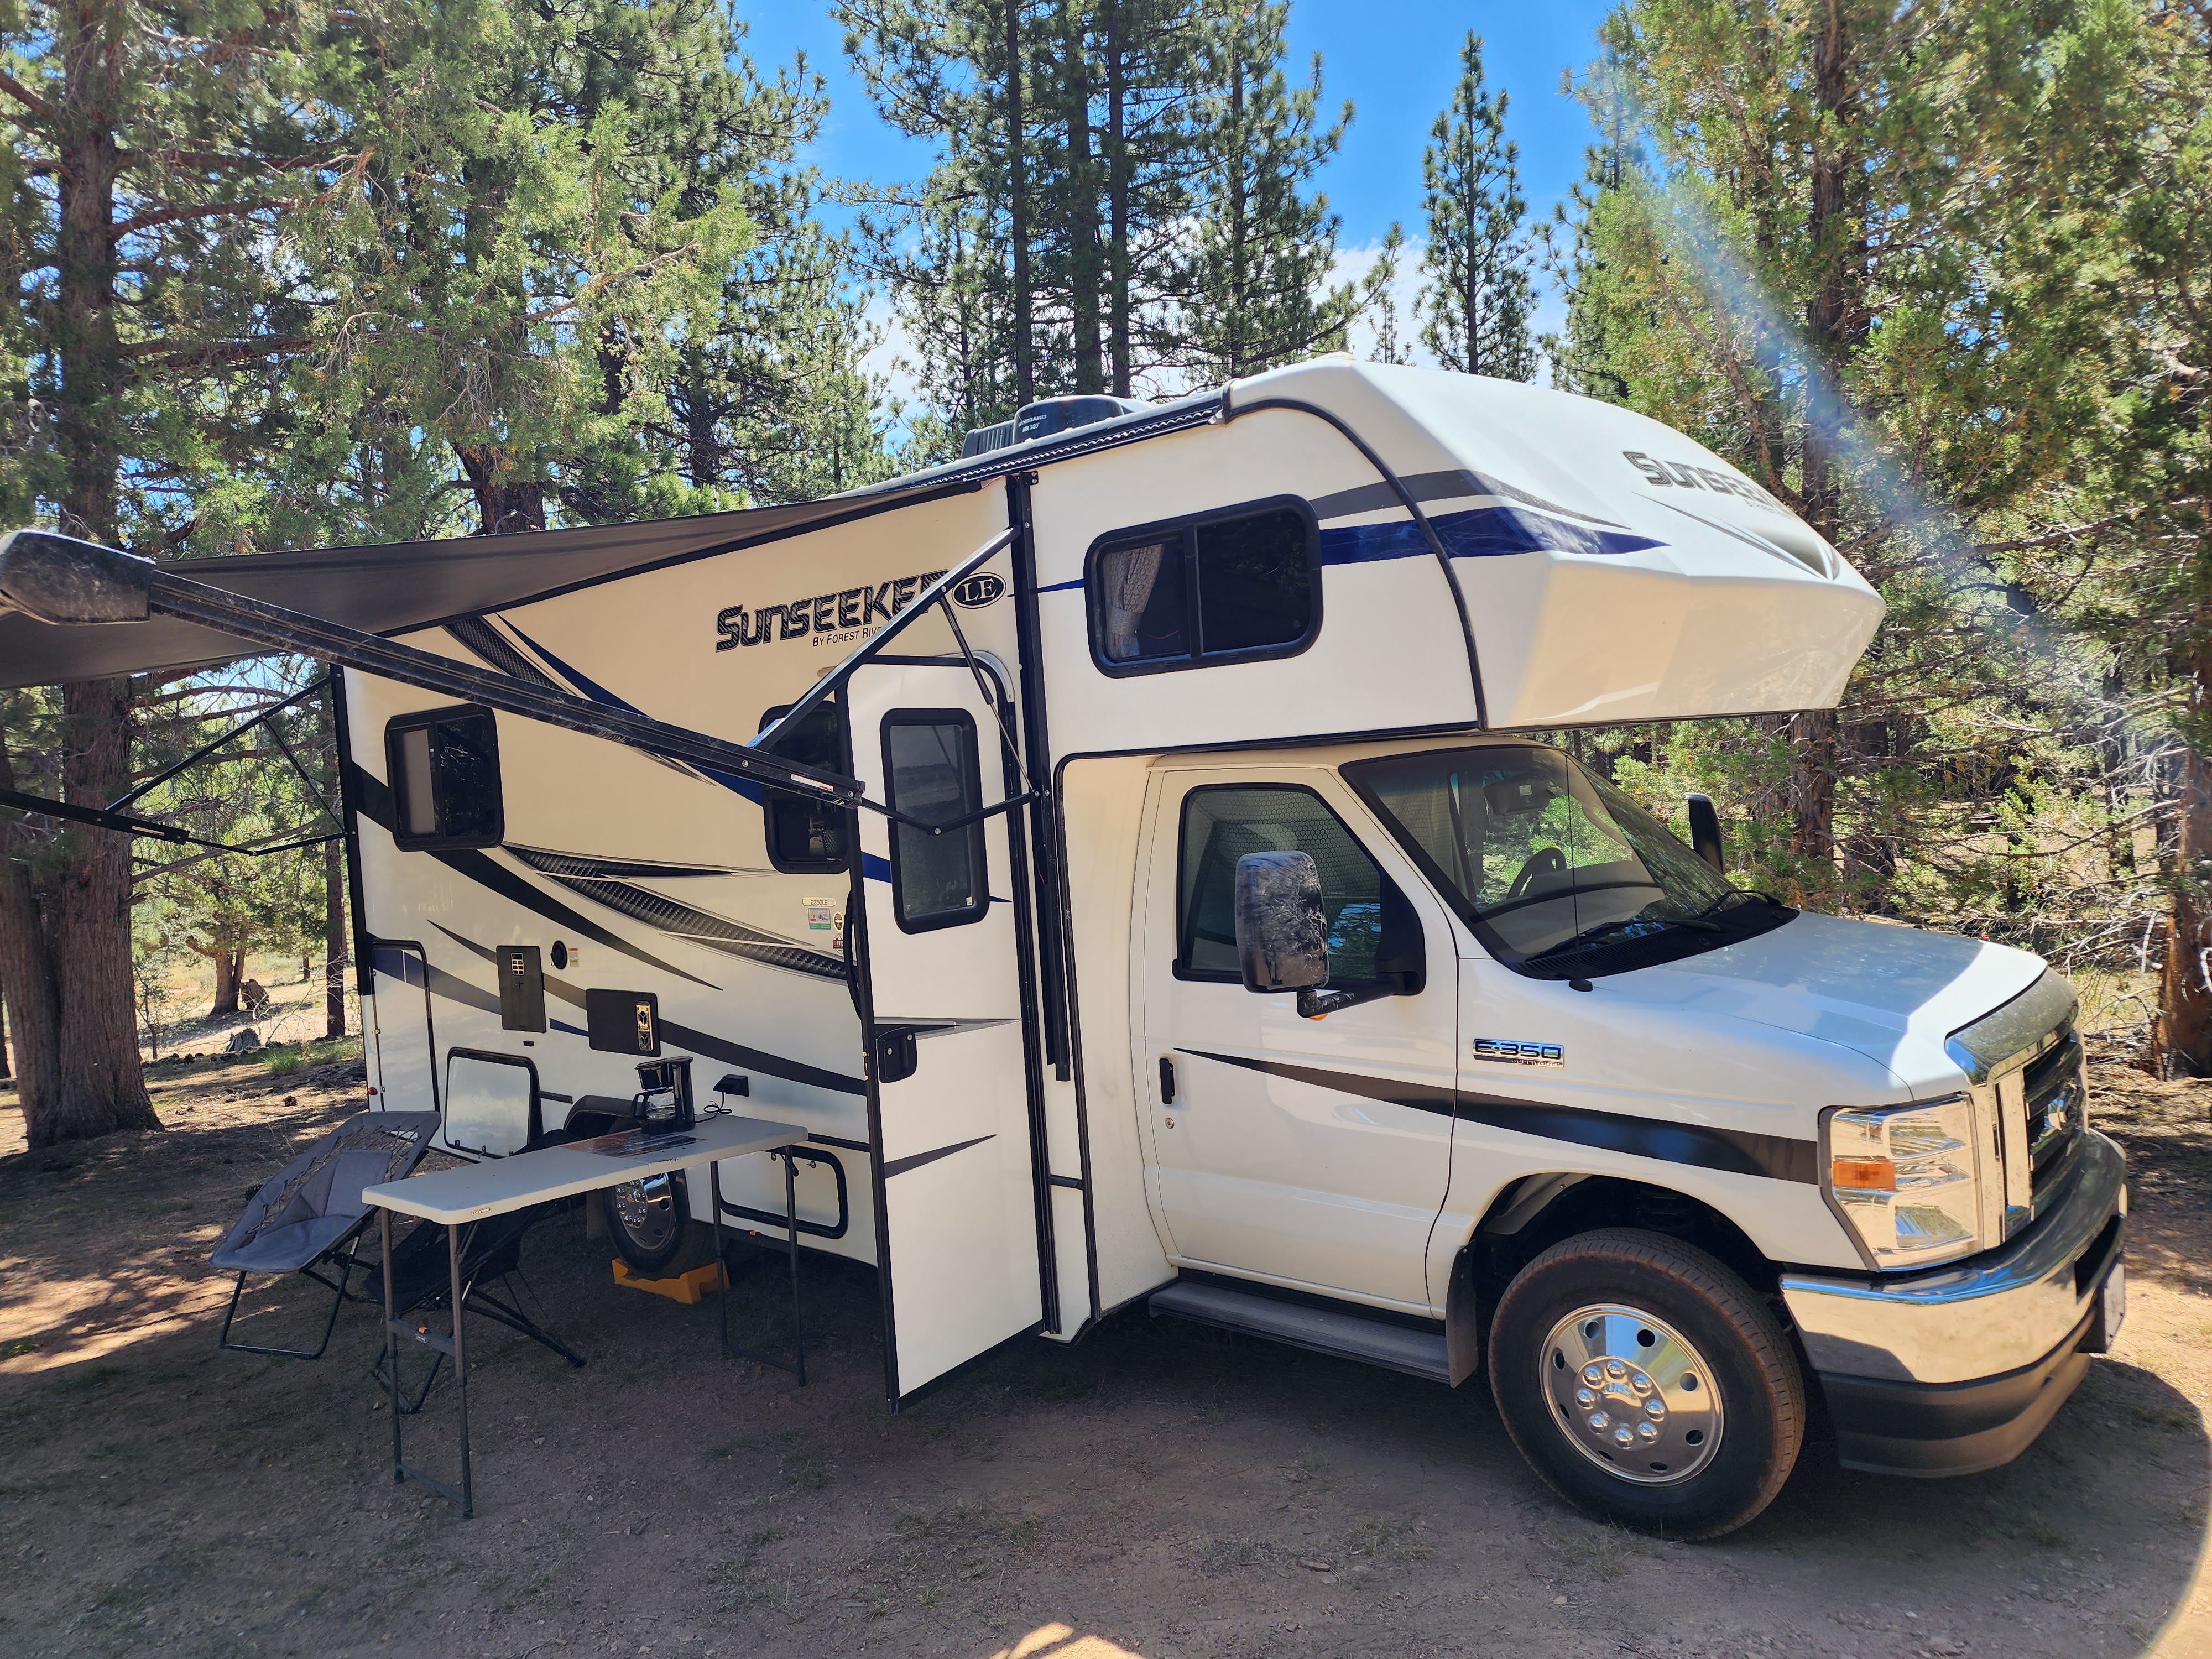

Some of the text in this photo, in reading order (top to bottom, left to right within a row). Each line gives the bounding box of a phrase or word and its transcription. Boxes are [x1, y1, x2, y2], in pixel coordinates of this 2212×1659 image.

[961, 577, 995, 603] LE
[813, 626, 883, 647] BY FOREST RIV
[1475, 1040, 1562, 1060] E-350
